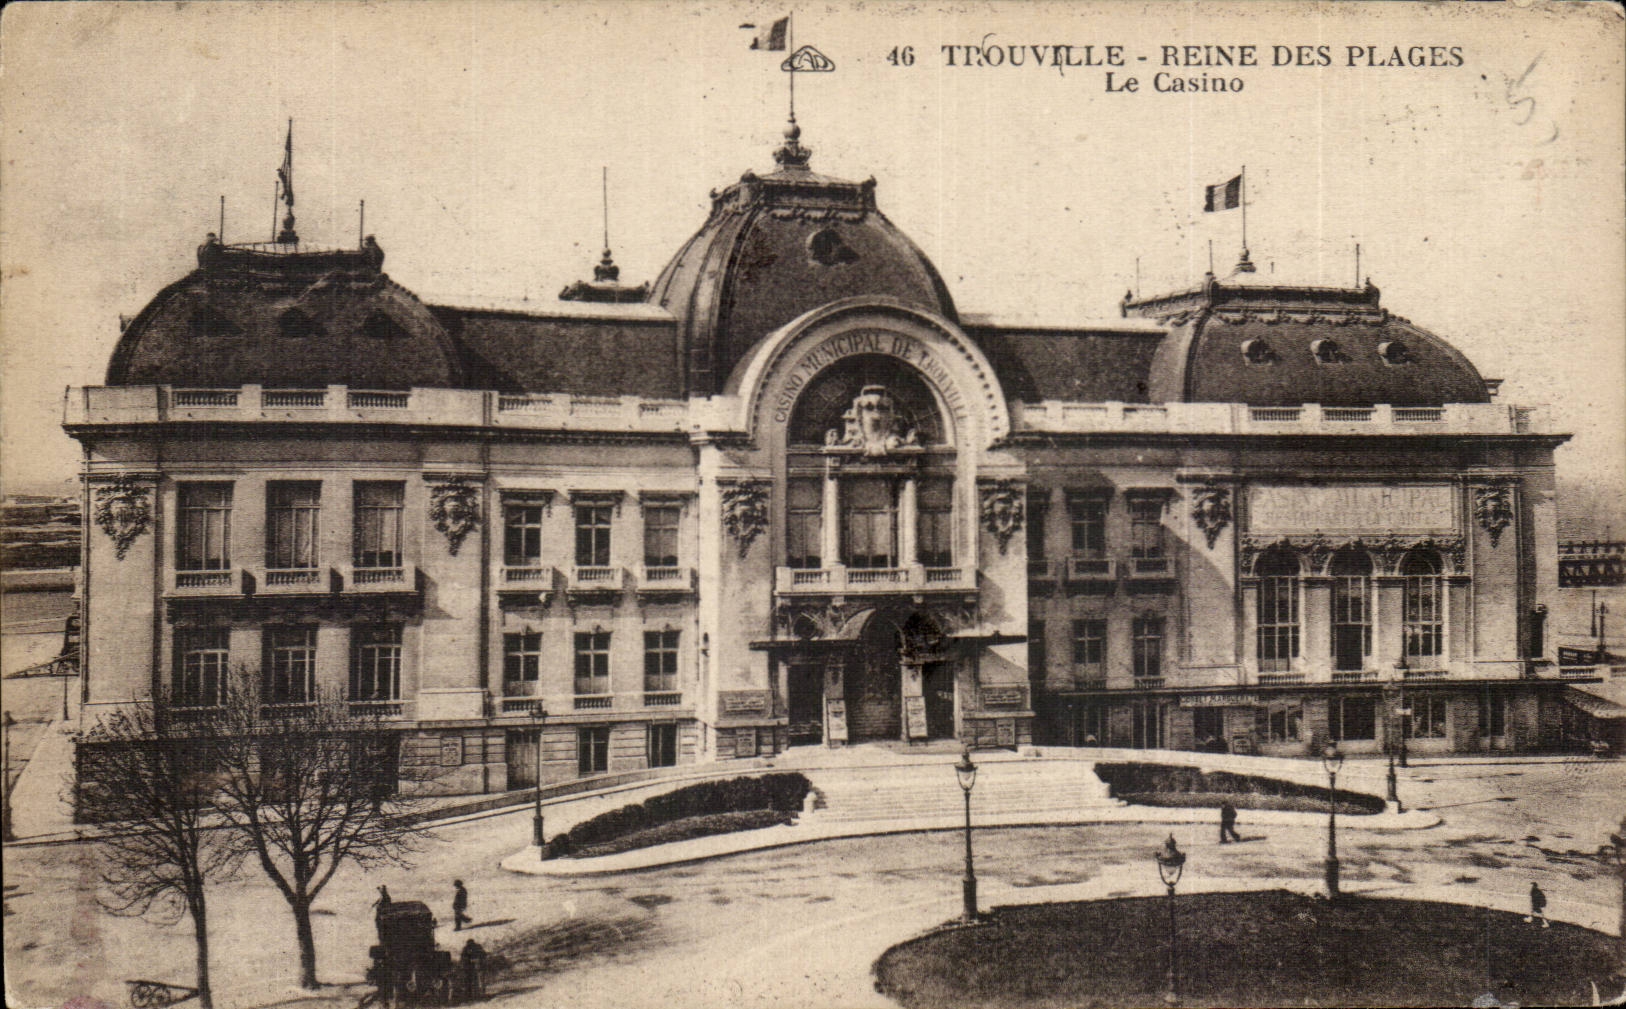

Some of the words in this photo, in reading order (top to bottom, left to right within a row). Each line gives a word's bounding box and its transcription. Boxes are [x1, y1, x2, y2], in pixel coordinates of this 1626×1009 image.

[774, 373, 805, 423] CASINO
[800, 332, 885, 379] MUNICIPAL
[891, 336, 913, 359] DE
